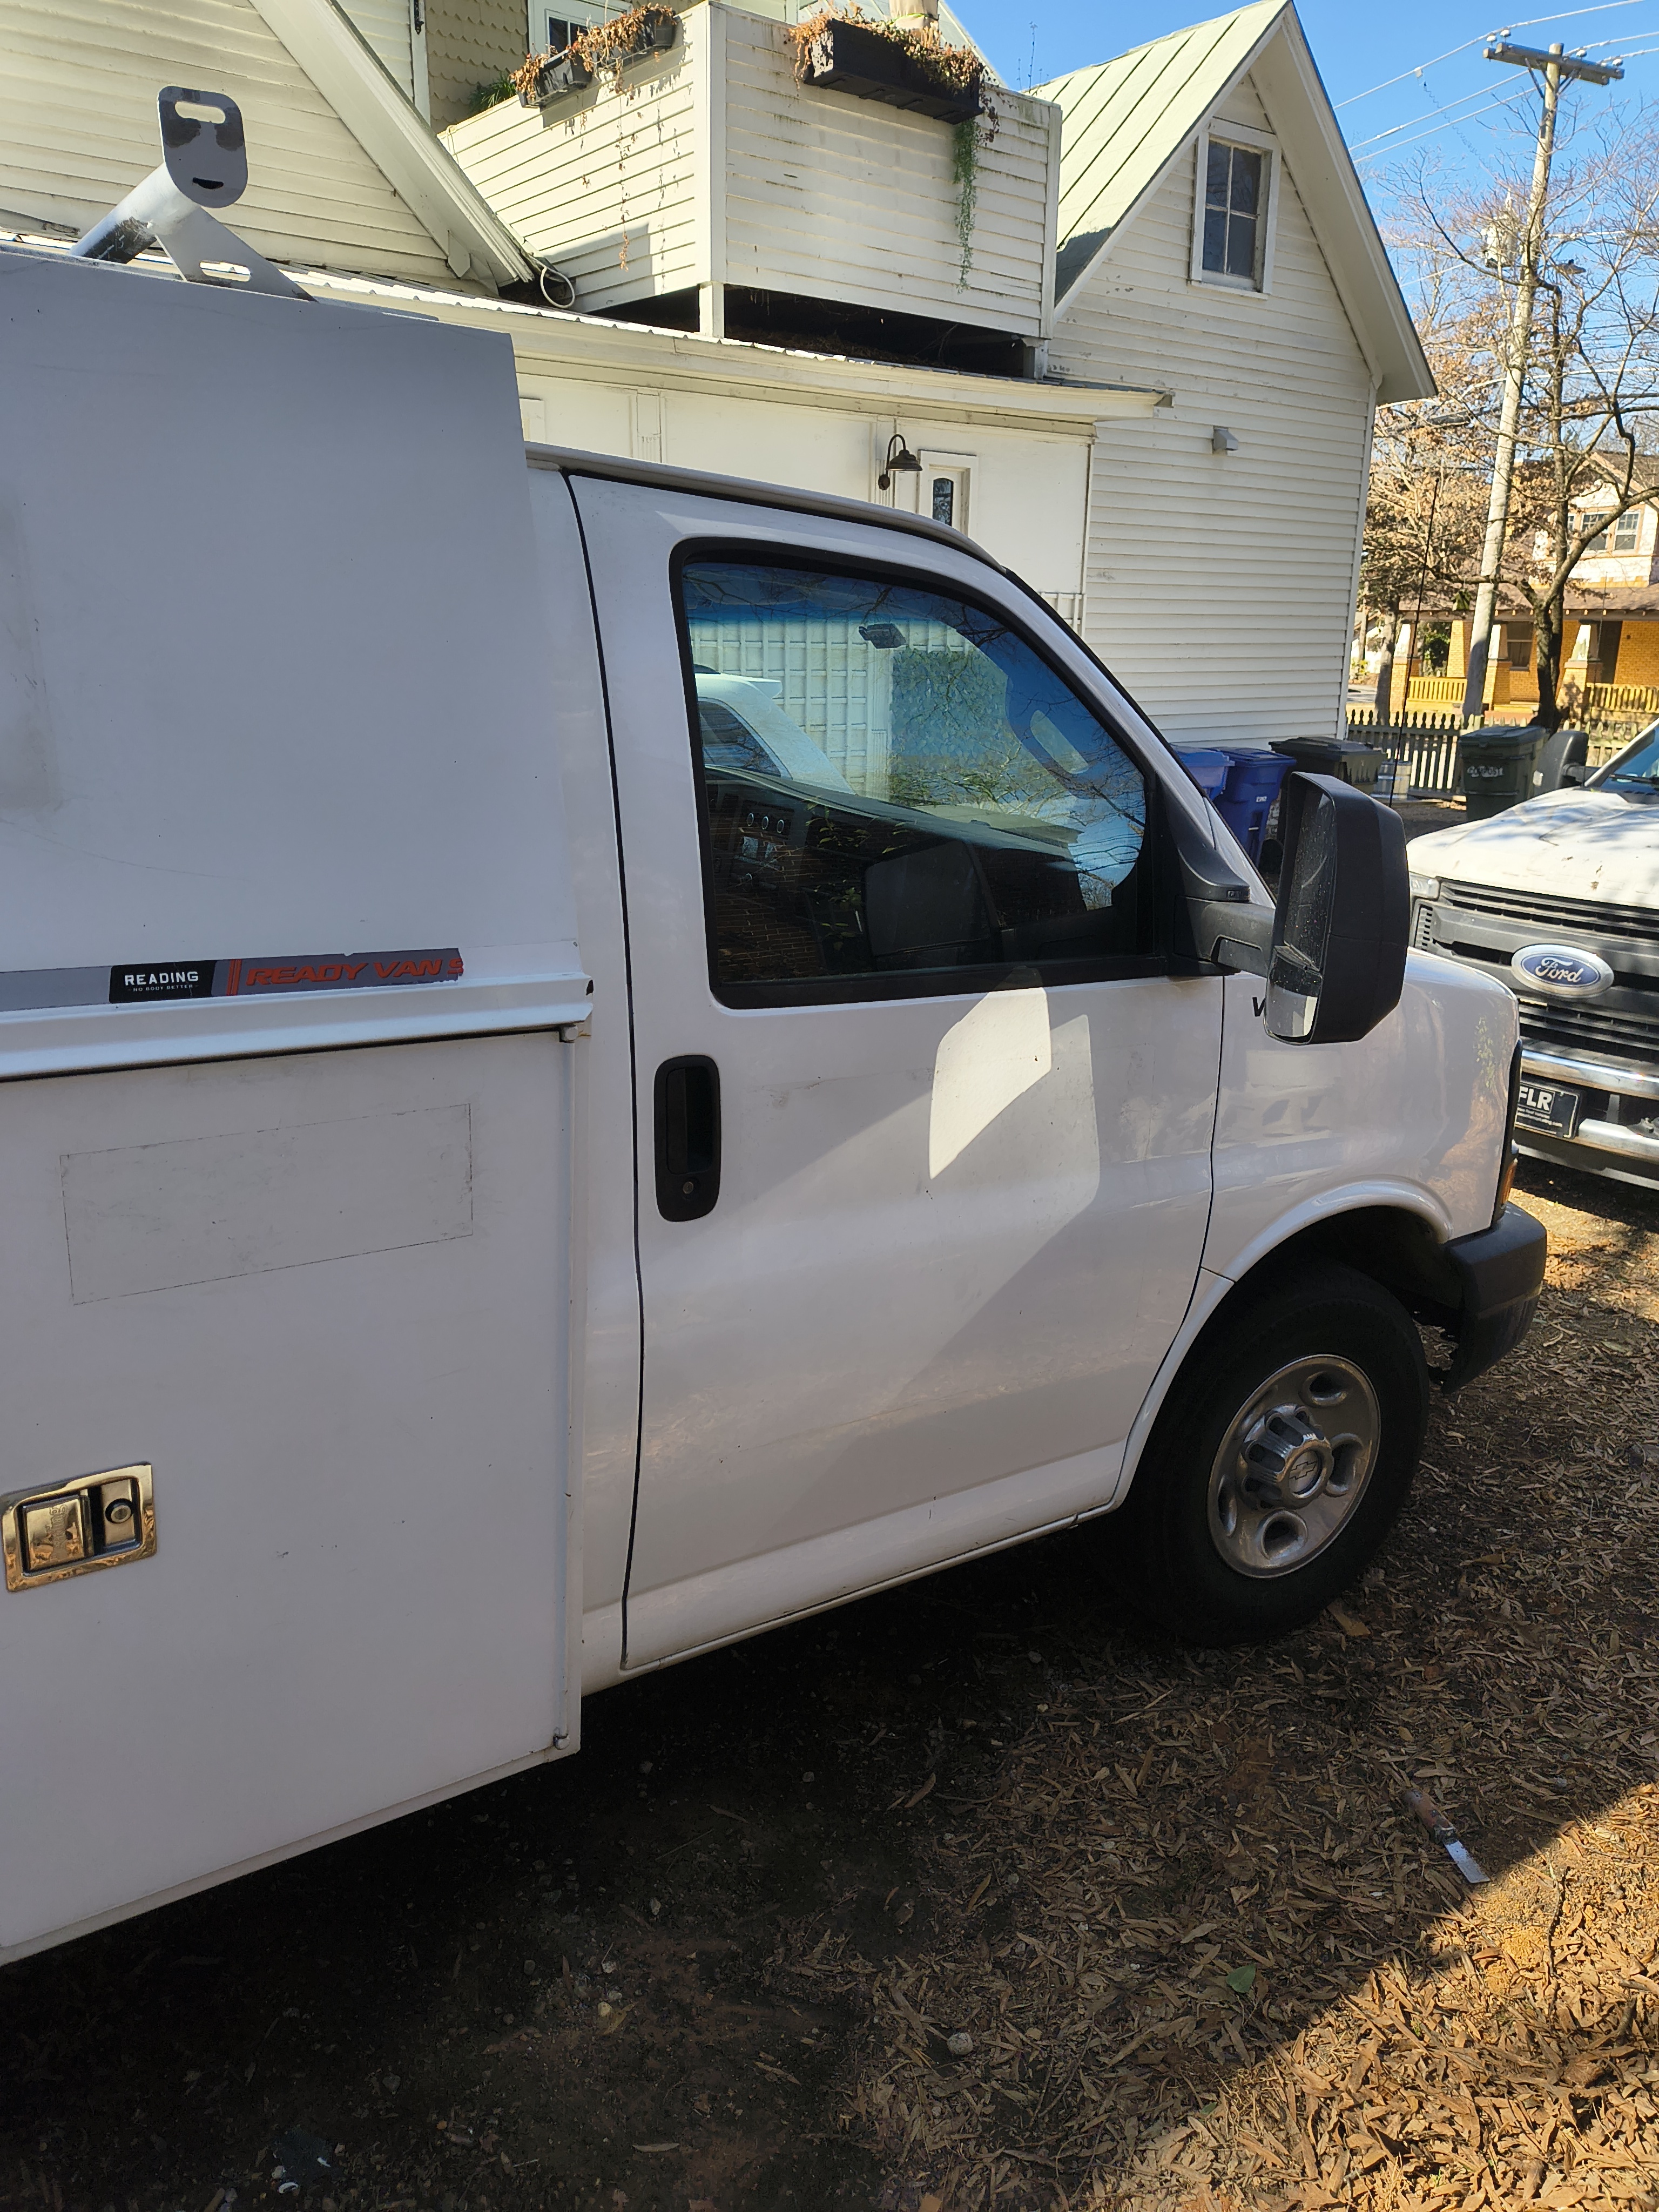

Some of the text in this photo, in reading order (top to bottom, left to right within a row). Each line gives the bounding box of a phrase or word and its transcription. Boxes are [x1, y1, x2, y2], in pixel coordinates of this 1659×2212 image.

[124, 971, 199, 986] READING
[246, 962, 369, 986] READY
[373, 959, 443, 979] VAN
[1535, 957, 1584, 983] Ford
